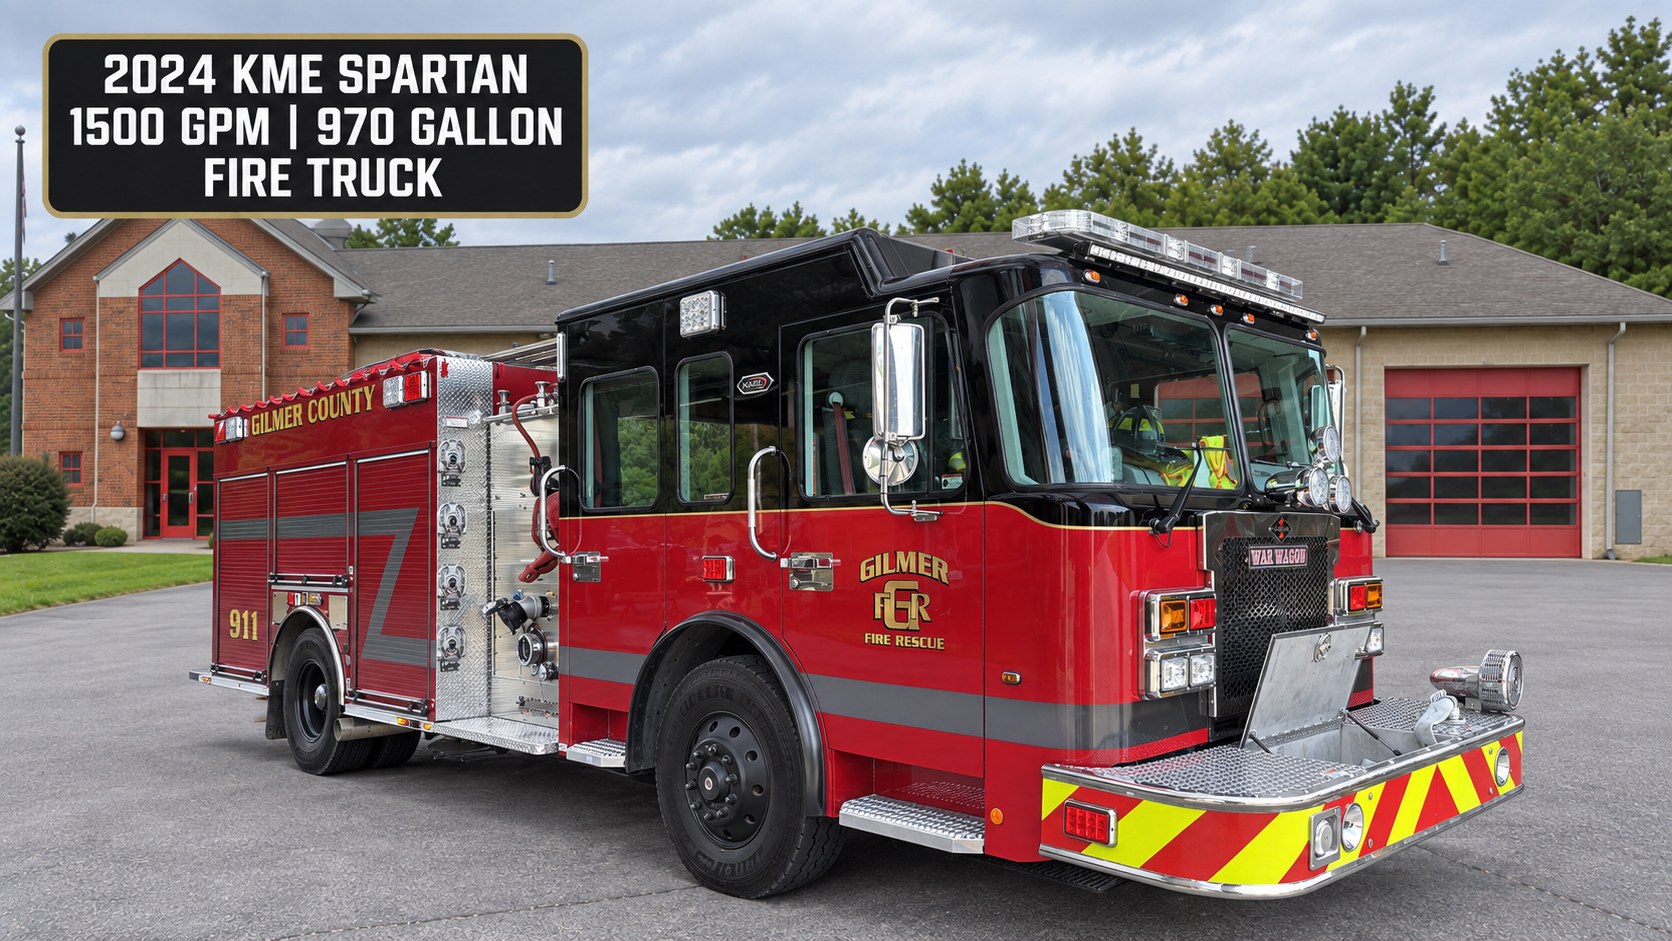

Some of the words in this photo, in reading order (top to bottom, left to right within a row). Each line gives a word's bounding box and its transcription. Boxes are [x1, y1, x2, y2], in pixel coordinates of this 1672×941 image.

[252, 403, 303, 436] GILMER
[307, 386, 375, 423] COUNTY
[860, 551, 949, 585] GILMER
[1251, 549, 1274, 565] WAR
[1275, 548, 1306, 564] WAGON
[229, 609, 258, 640] 911
[865, 633, 890, 645] FIRE
[895, 635, 944, 650] RESCUE
